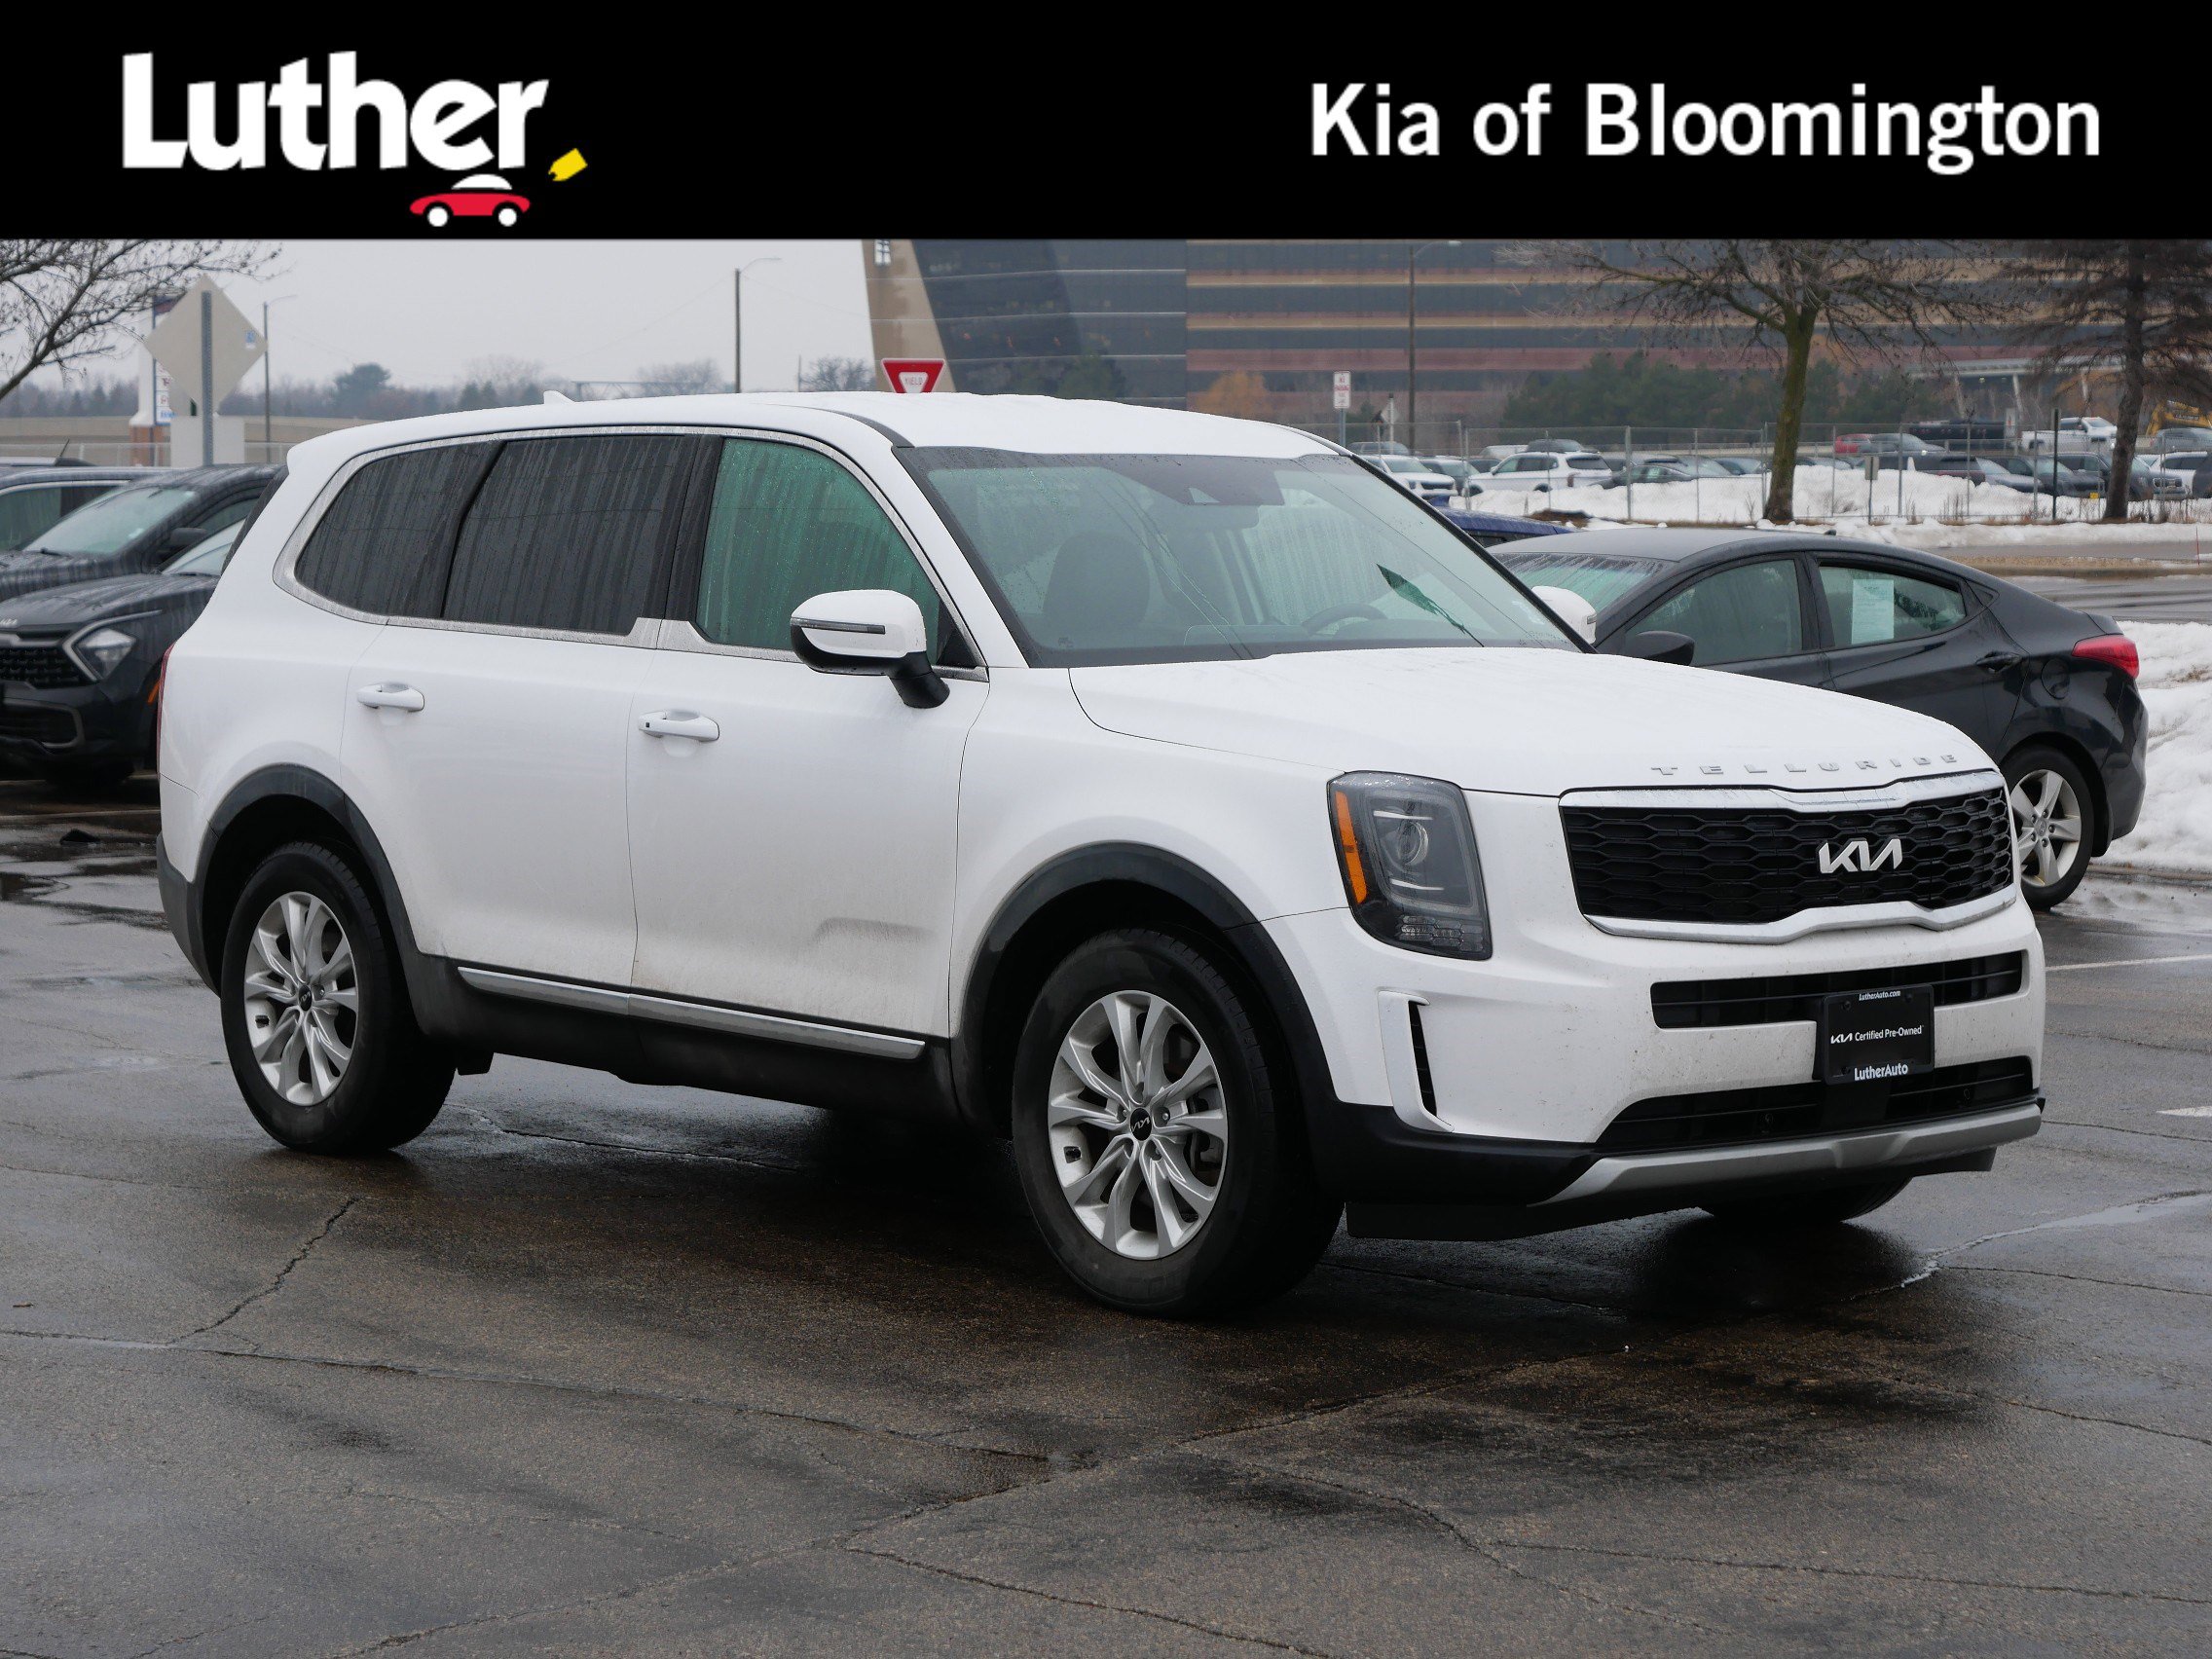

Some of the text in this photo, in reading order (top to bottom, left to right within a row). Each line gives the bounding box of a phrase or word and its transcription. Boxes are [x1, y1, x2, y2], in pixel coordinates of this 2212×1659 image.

[1650, 754, 1958, 776] TELLURIDE
[1818, 837, 1904, 874] KIA
[1858, 989, 1901, 1002] LutherAuto.com
[1829, 1025, 1924, 1045] KIA Certified Pre-Owned
[1854, 1062, 1909, 1082] LutherAuto
